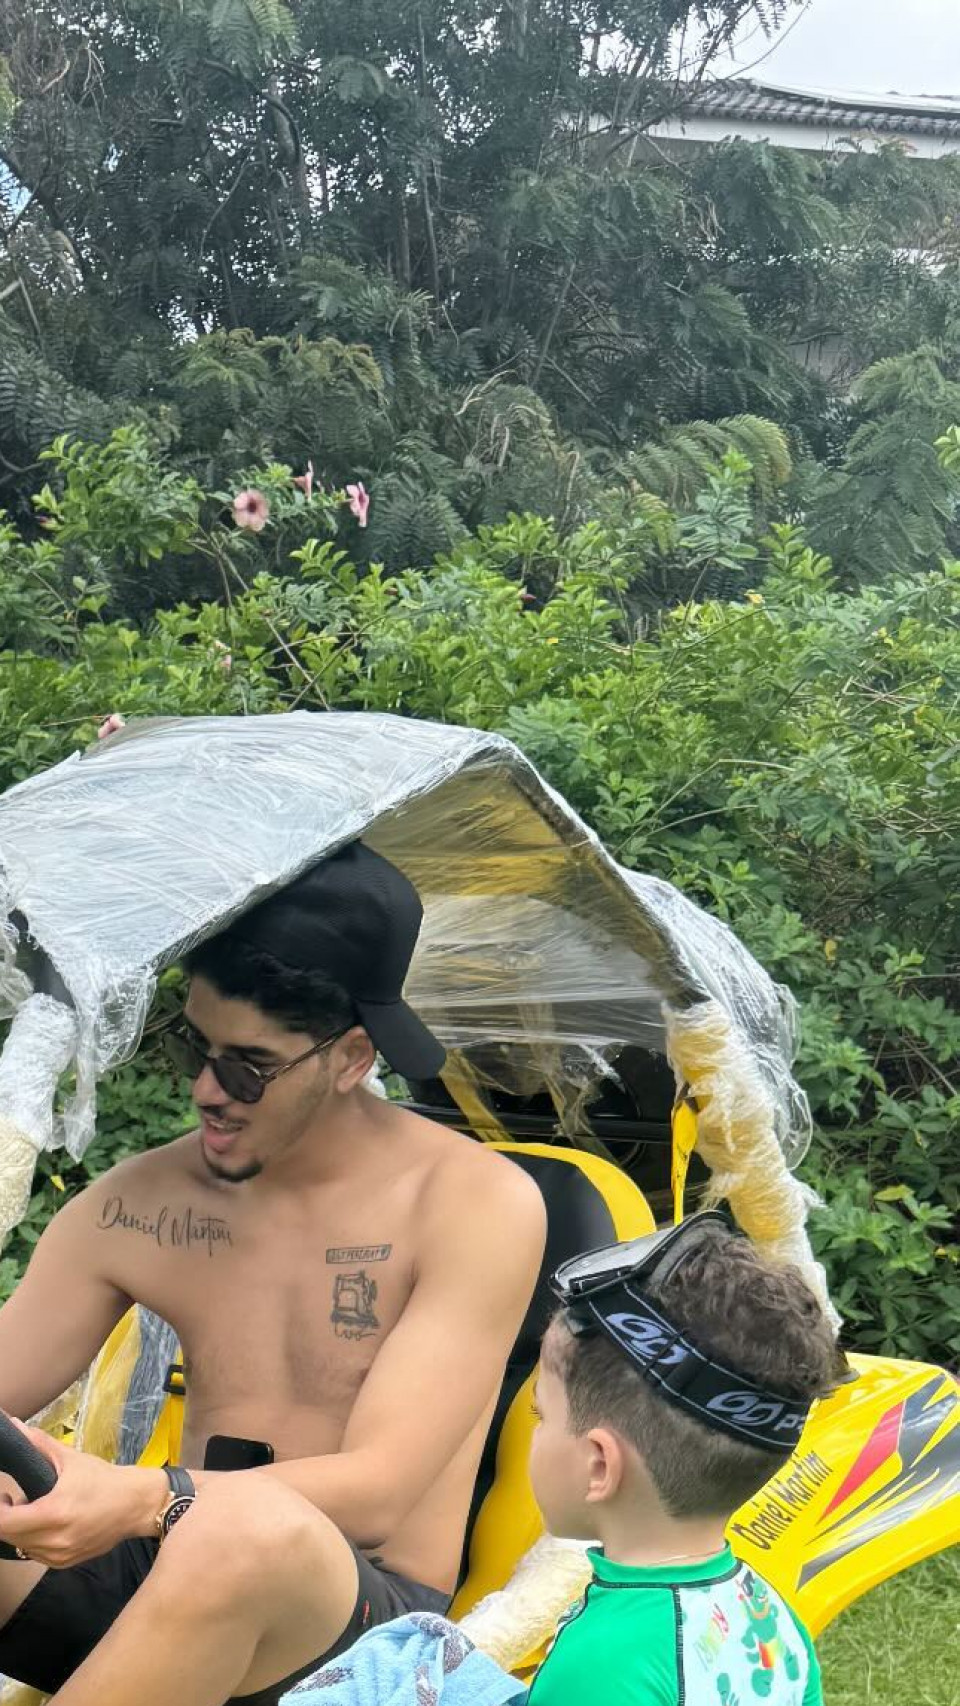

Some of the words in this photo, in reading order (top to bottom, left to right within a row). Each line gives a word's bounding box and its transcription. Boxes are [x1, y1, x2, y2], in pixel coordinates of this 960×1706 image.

[97, 1196, 168, 1247] Daniel
[730, 1490, 798, 1550] Daniel
[766, 1450, 834, 1512] Martim
